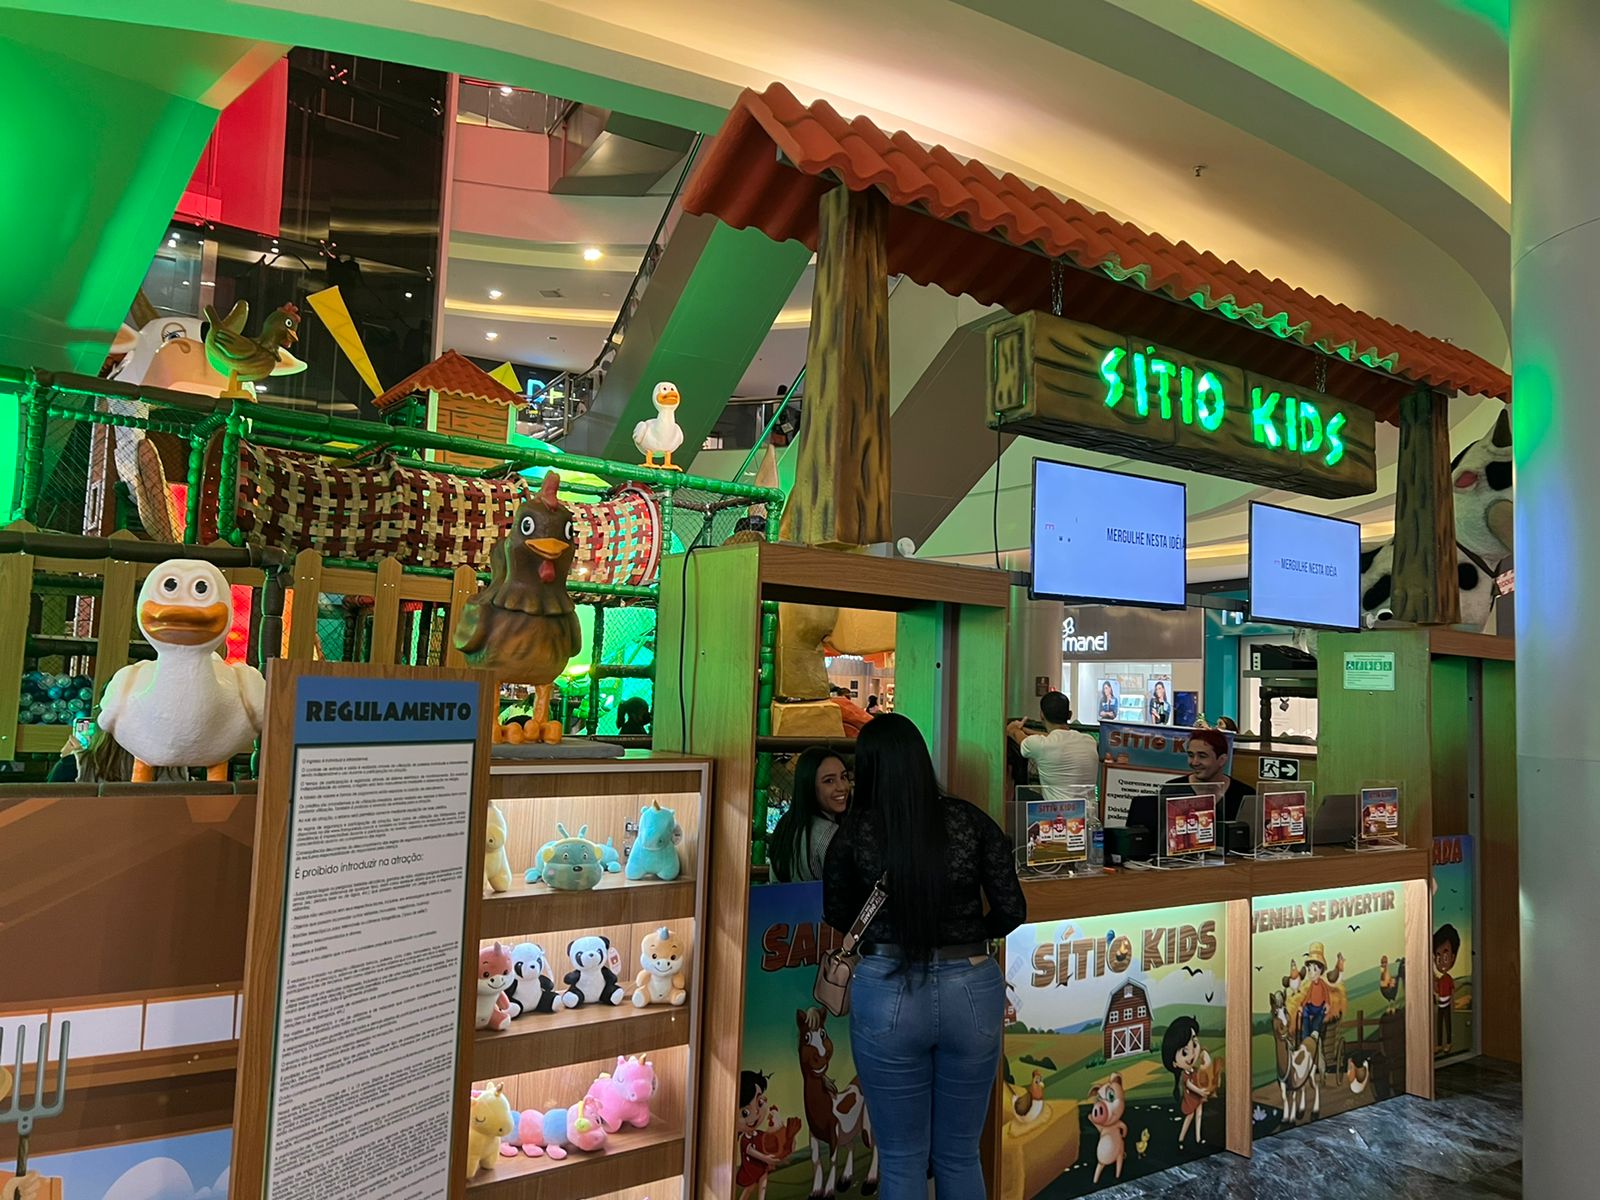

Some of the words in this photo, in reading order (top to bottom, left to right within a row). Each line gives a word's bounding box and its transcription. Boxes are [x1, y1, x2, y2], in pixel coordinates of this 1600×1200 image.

[1100, 345, 1225, 432] SÍTIO
[1251, 386, 1347, 467] KIDS
[1107, 528, 1144, 546] MERGULHE
[1146, 533, 1168, 549] NESTA
[1281, 558, 1308, 573] MERGULHE
[1309, 562, 1324, 575] NESTA
[1062, 631, 1108, 652] manel
[305, 700, 472, 723] REGULAMENTO
[294, 867, 301, 880] É
[302, 863, 339, 881] proibido
[340, 857, 377, 873] introduzir
[378, 857, 390, 868] na
[391, 852, 424, 866] atração:
[1253, 904, 1305, 934] VENHA
[1308, 901, 1326, 924] SE
[1328, 890, 1396, 920] DIVERTIR
[1031, 925, 1133, 988] SÍTIO
[1141, 920, 1217, 972] KIDS
